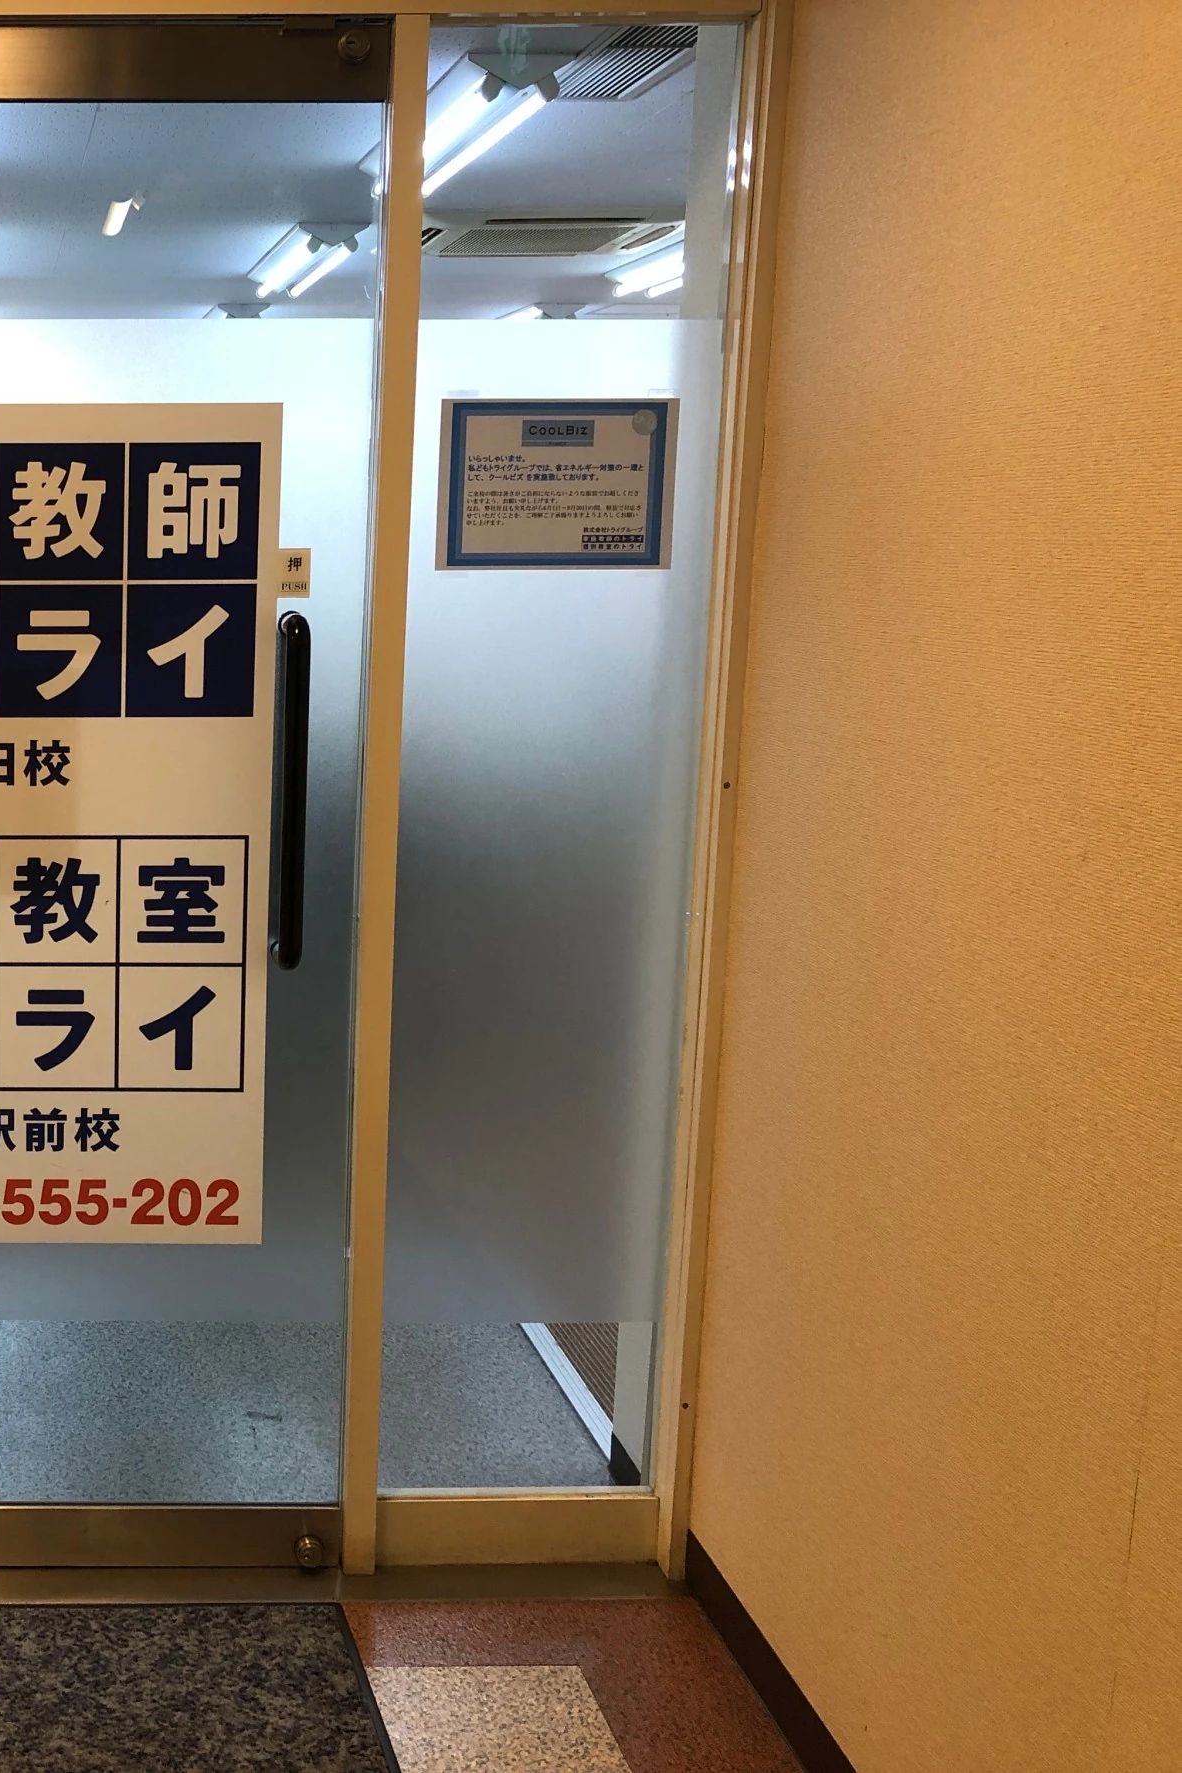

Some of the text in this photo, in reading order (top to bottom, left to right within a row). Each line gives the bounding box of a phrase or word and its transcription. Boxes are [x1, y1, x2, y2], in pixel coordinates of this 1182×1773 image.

[468, 455, 526, 463] いらっしゃいませ。
[287, 557, 302, 572] 押
[281, 583, 307, 591] PUSH
